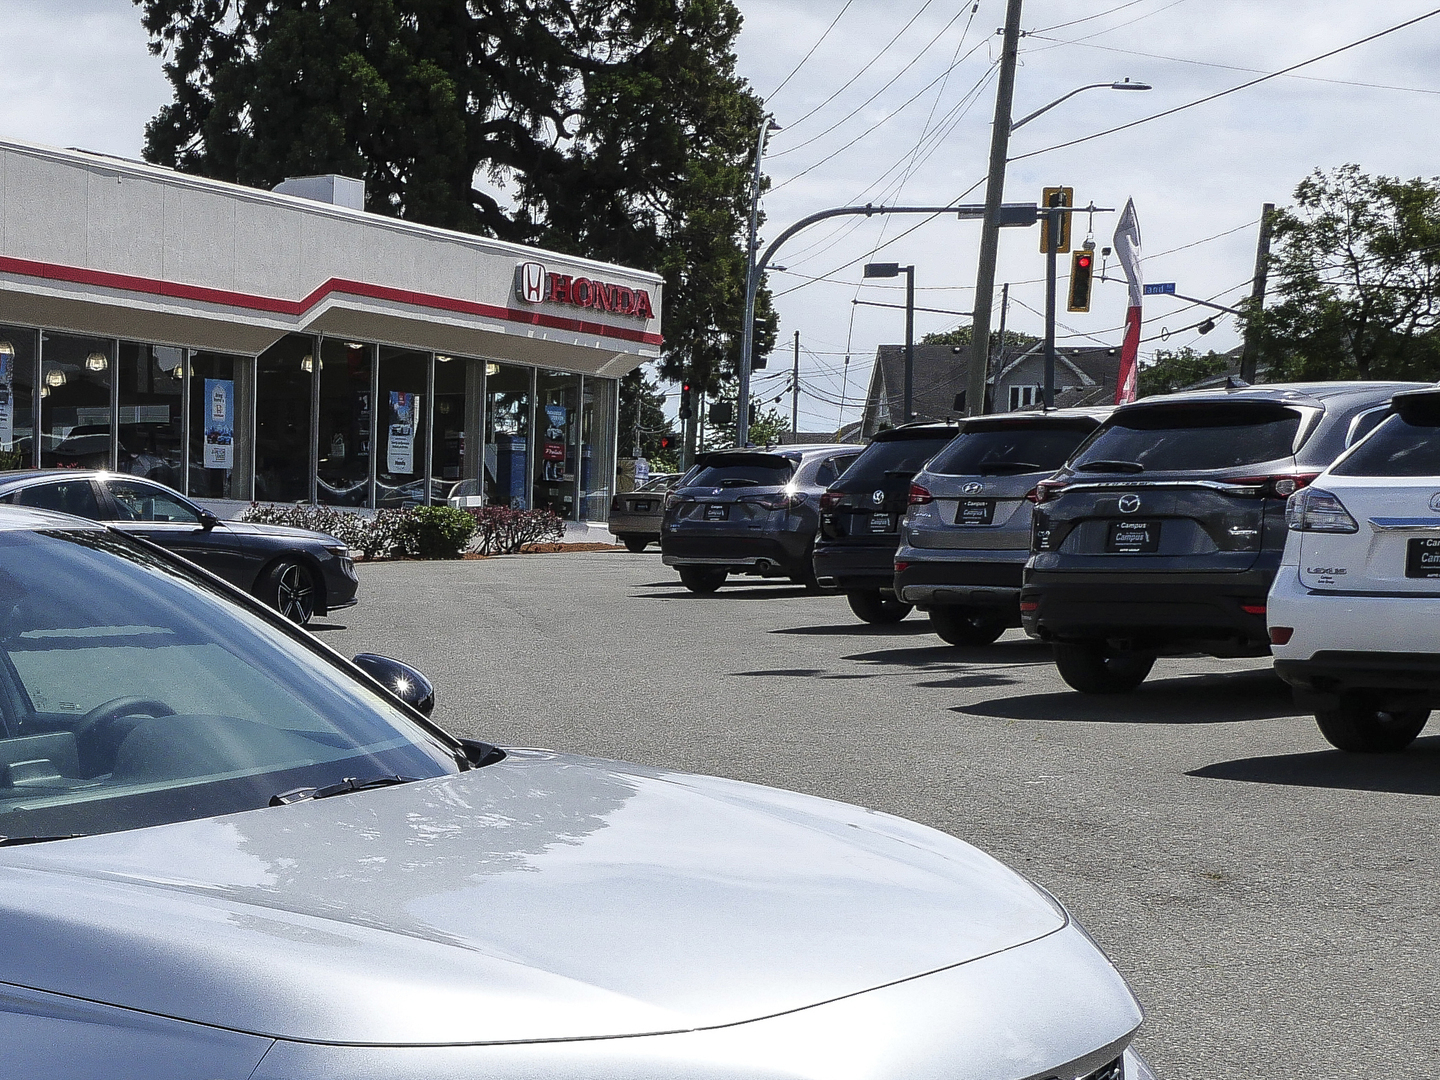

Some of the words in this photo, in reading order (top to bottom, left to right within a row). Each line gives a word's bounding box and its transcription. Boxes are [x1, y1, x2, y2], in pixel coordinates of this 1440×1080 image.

[546, 271, 655, 320] HONDA
[1120, 522, 1147, 530] Campus
[1115, 532, 1144, 543] Campus
[1306, 567, 1347, 575] LEXUS
